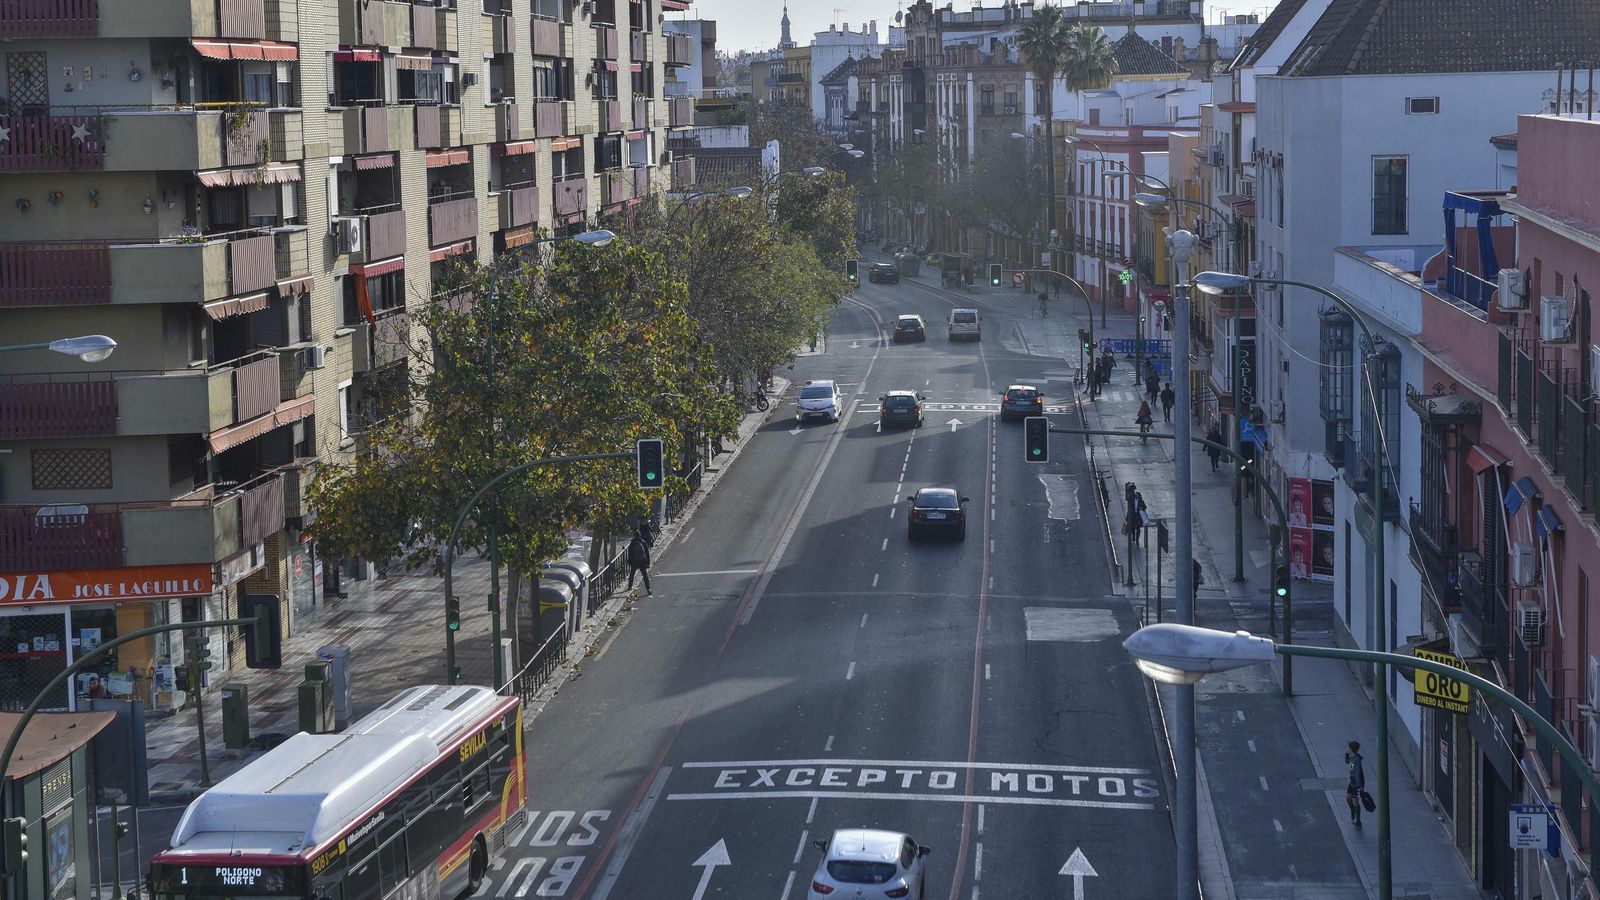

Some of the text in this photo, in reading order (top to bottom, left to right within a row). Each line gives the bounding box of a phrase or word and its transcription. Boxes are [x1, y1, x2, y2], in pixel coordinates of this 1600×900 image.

[72, 583, 113, 598] JOSE
[119, 578, 204, 595] LAGUILLO
[1426, 672, 1461, 698] ORO
[1416, 695, 1437, 706] DINERO
[1437, 699, 1445, 709] AL
[459, 729, 487, 762] SEVILLA
[713, 767, 1161, 799] EXCEPTO MOTOS
[181, 867, 262, 884] 1 POLIGONO
[223, 876, 255, 885] NORTE
